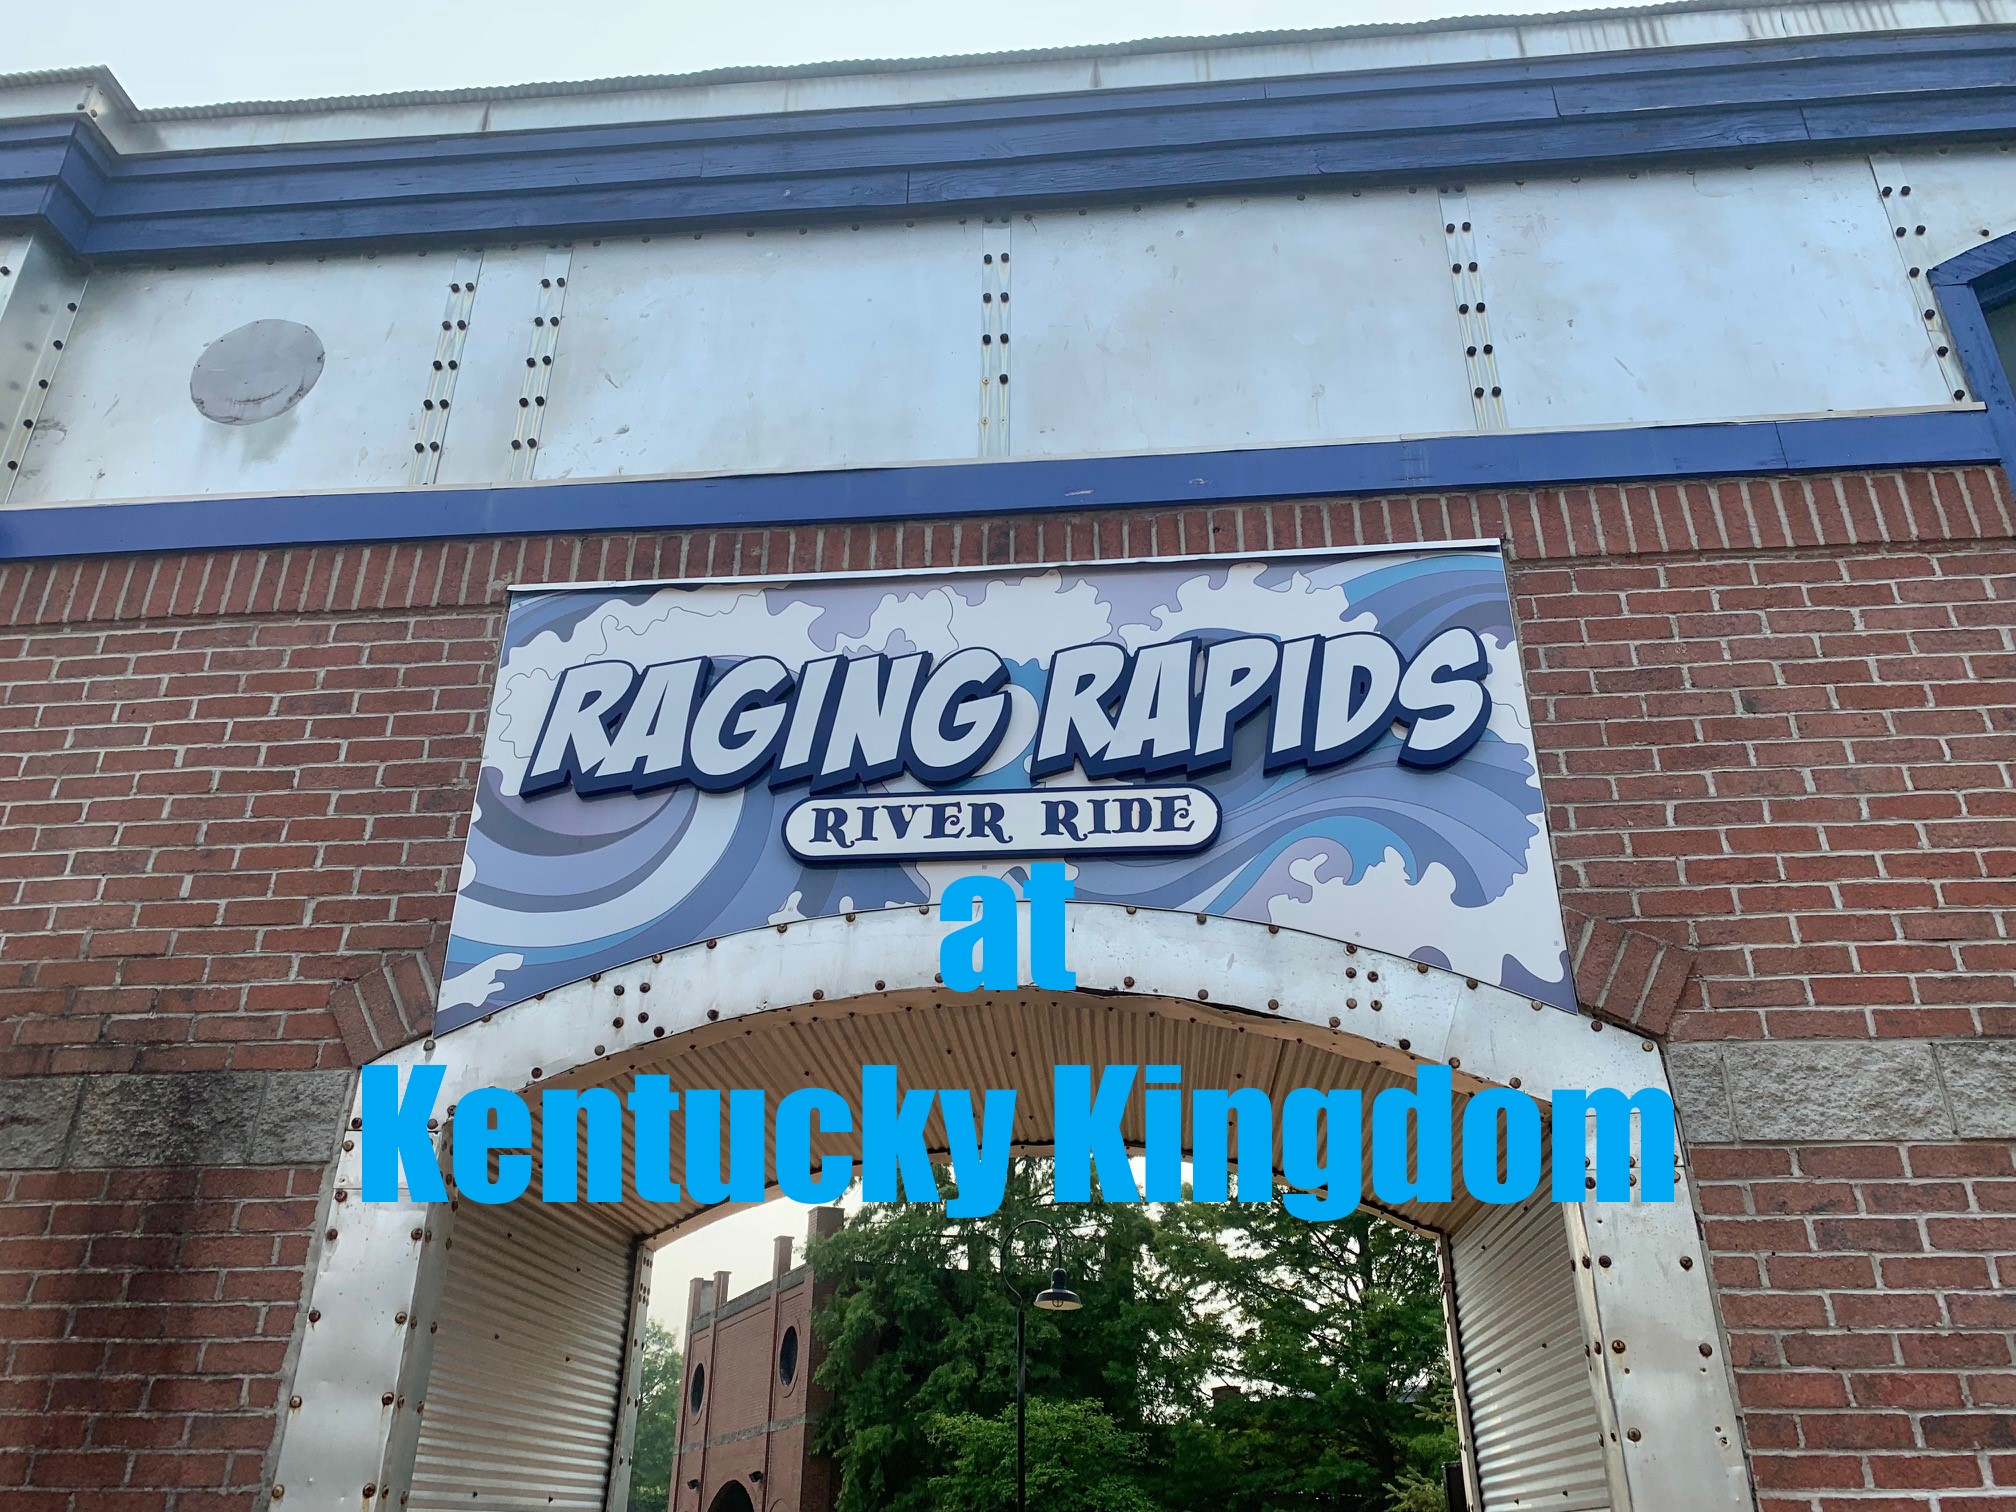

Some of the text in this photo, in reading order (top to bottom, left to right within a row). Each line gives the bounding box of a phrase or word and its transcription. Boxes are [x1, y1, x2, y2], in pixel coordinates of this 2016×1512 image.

[520, 627, 1490, 799] RAGING RAPIDS
[808, 795, 1195, 848] RIVER RIDE
